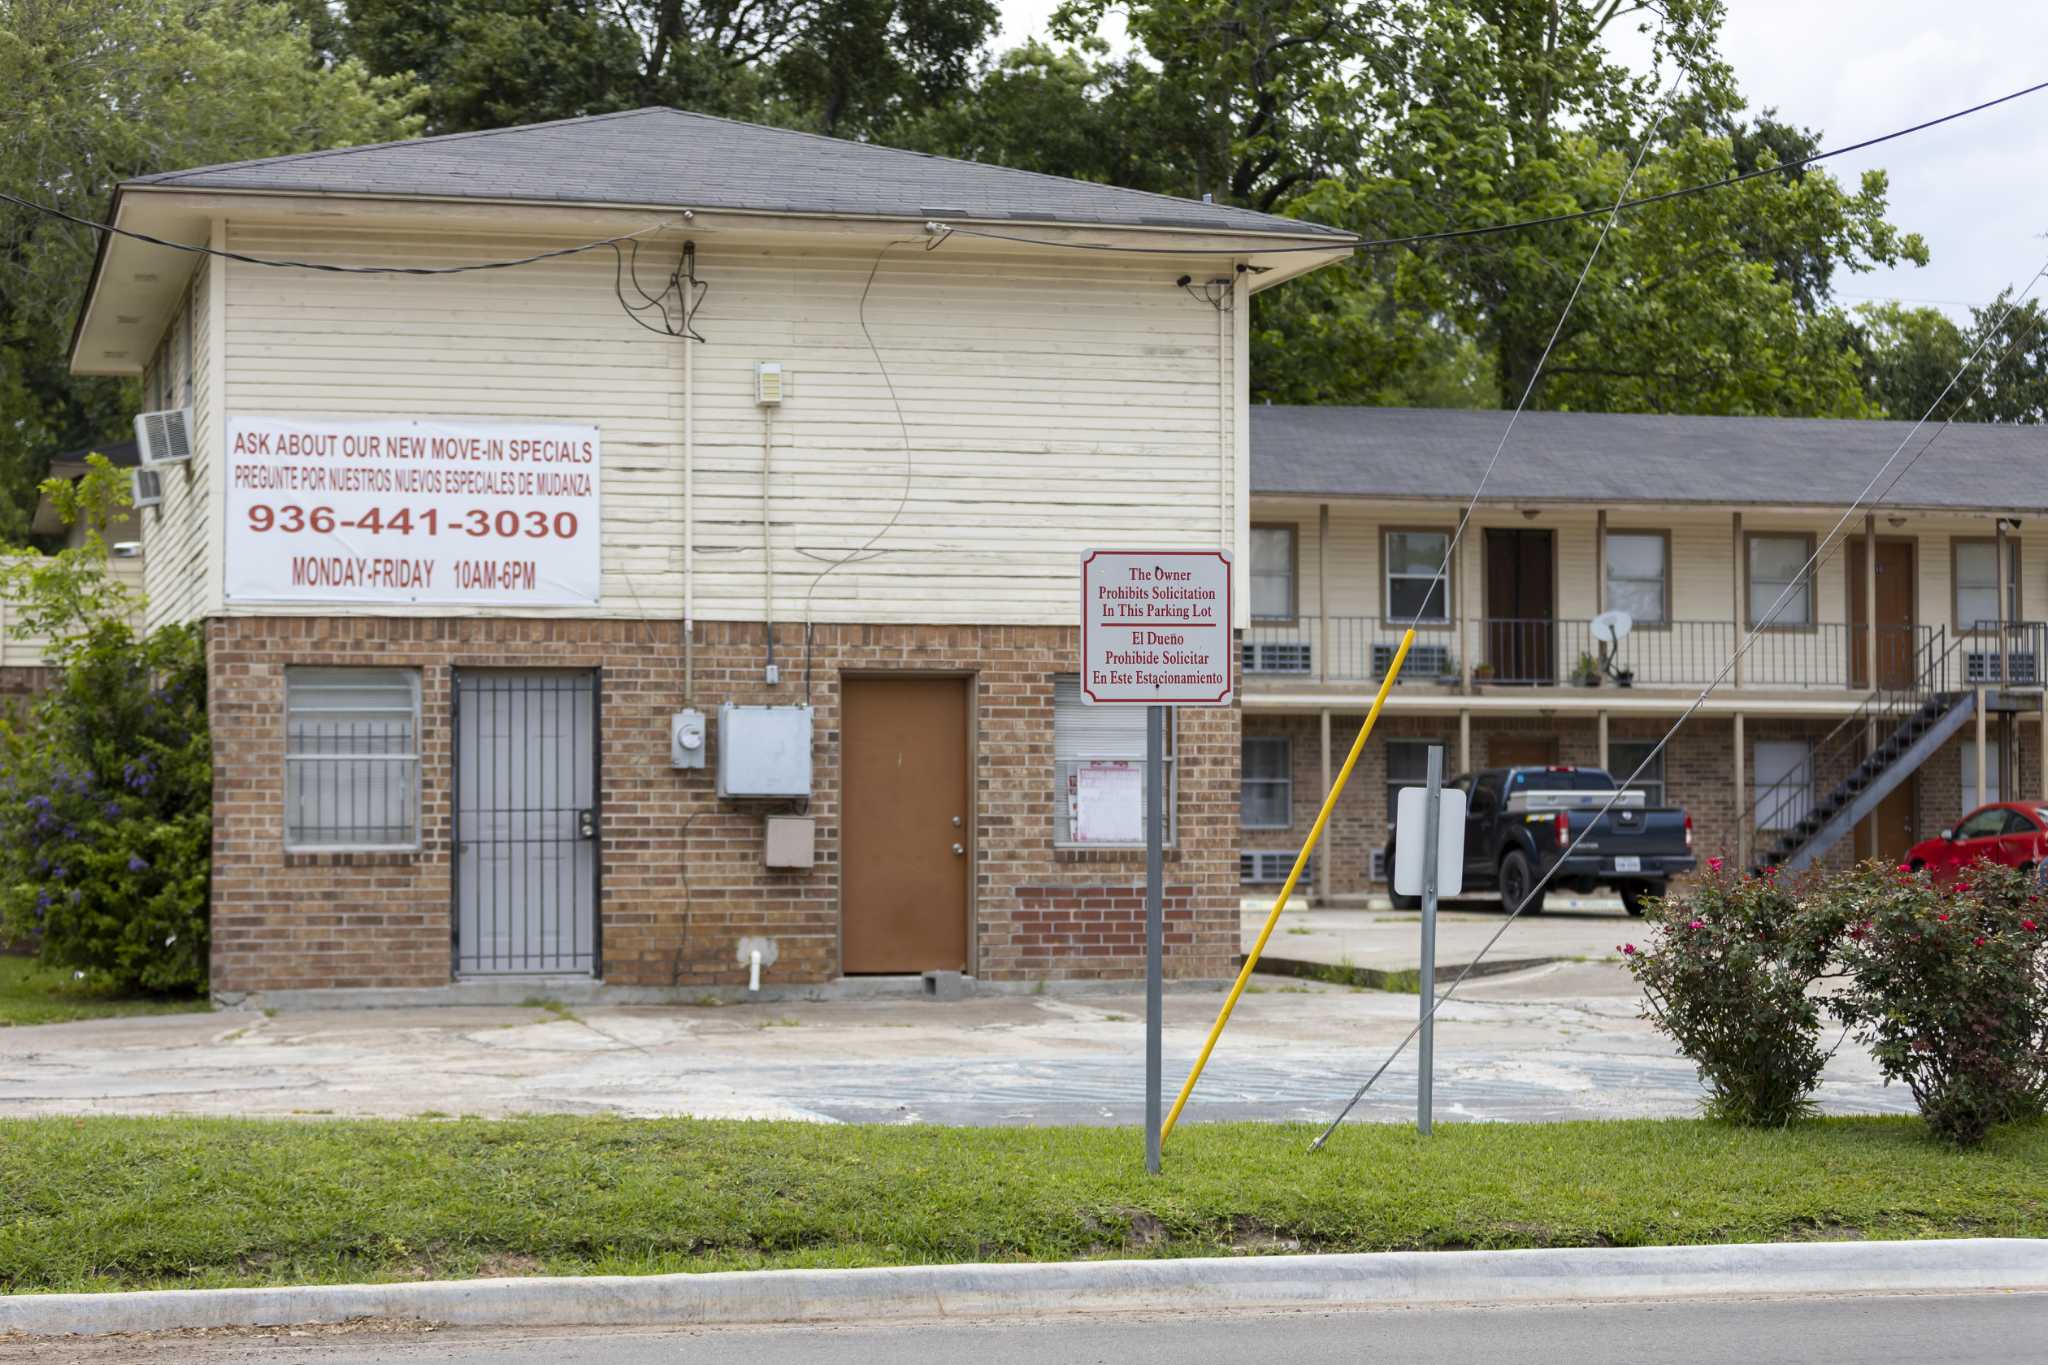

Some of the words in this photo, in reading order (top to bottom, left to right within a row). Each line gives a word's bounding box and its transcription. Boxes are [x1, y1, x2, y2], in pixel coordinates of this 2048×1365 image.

[233, 432, 271, 455] ASK
[275, 433, 338, 456] ABOUT
[343, 435, 381, 458] OUR
[386, 436, 426, 459] NEW
[431, 438, 504, 462] MOVE-IN
[508, 440, 592, 463] SPECIALS
[234, 465, 298, 490] PREGUNTE
[301, 466, 326, 491] POR
[328, 468, 391, 493] NUESTROS
[395, 469, 442, 494] NUEVOS
[445, 470, 515, 495] ESPECIALES
[518, 472, 533, 496] DE
[536, 473, 592, 497] MUDANZA
[247, 504, 578, 539] 936-441-3030
[291, 556, 434, 589] MONDAY-FRIDAY
[453, 559, 536, 591] 10AM-6PM
[1129, 567, 1151, 581] The
[1154, 567, 1192, 581] Owner
[1099, 586, 1149, 600] Prohibits
[1152, 586, 1216, 600] Solicitation
[1102, 604, 1114, 617] In
[1118, 604, 1144, 617] This
[1147, 604, 1190, 620] Parking
[1192, 604, 1212, 617] Lot
[1132, 631, 1144, 645] El
[1147, 631, 1184, 645] Dueño
[1105, 651, 1160, 665] Prohibide
[1162, 651, 1209, 665] Solicitar
[1092, 670, 1107, 684] En
[1110, 670, 1133, 684] Este
[1136, 670, 1223, 685] Estacionamiento
